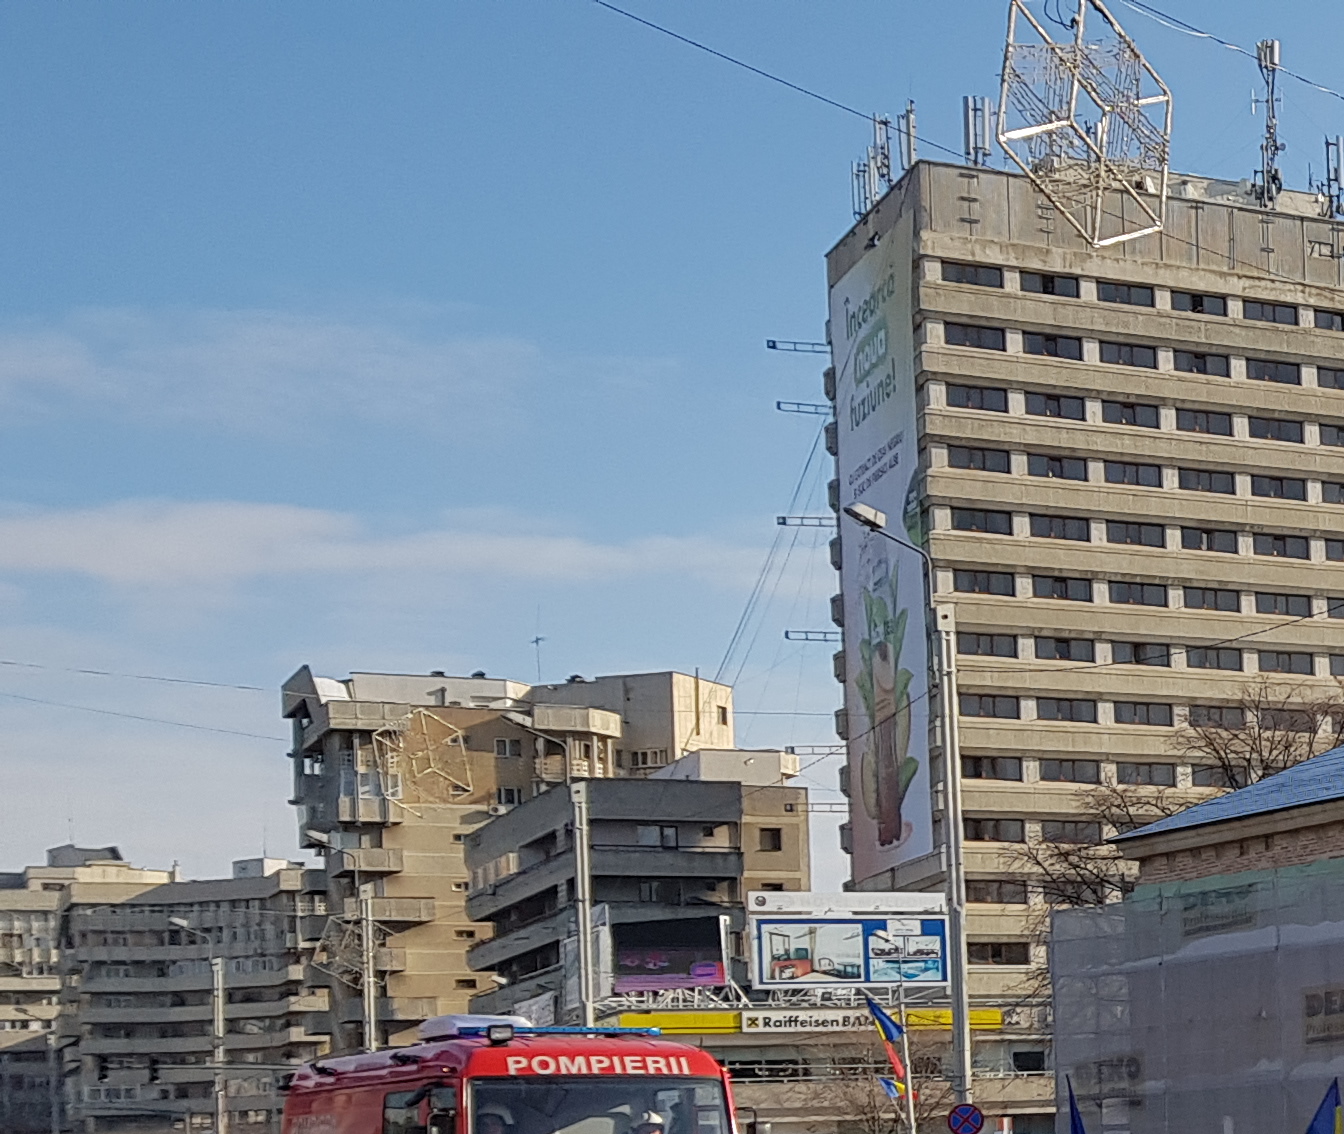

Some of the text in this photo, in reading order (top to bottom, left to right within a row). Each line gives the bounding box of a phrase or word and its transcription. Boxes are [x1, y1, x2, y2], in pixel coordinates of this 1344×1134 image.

[850, 357, 896, 432] fuziune!
[763, 1015, 840, 1028] Raiffeisen
[506, 1055, 691, 1076] POMPIERII
